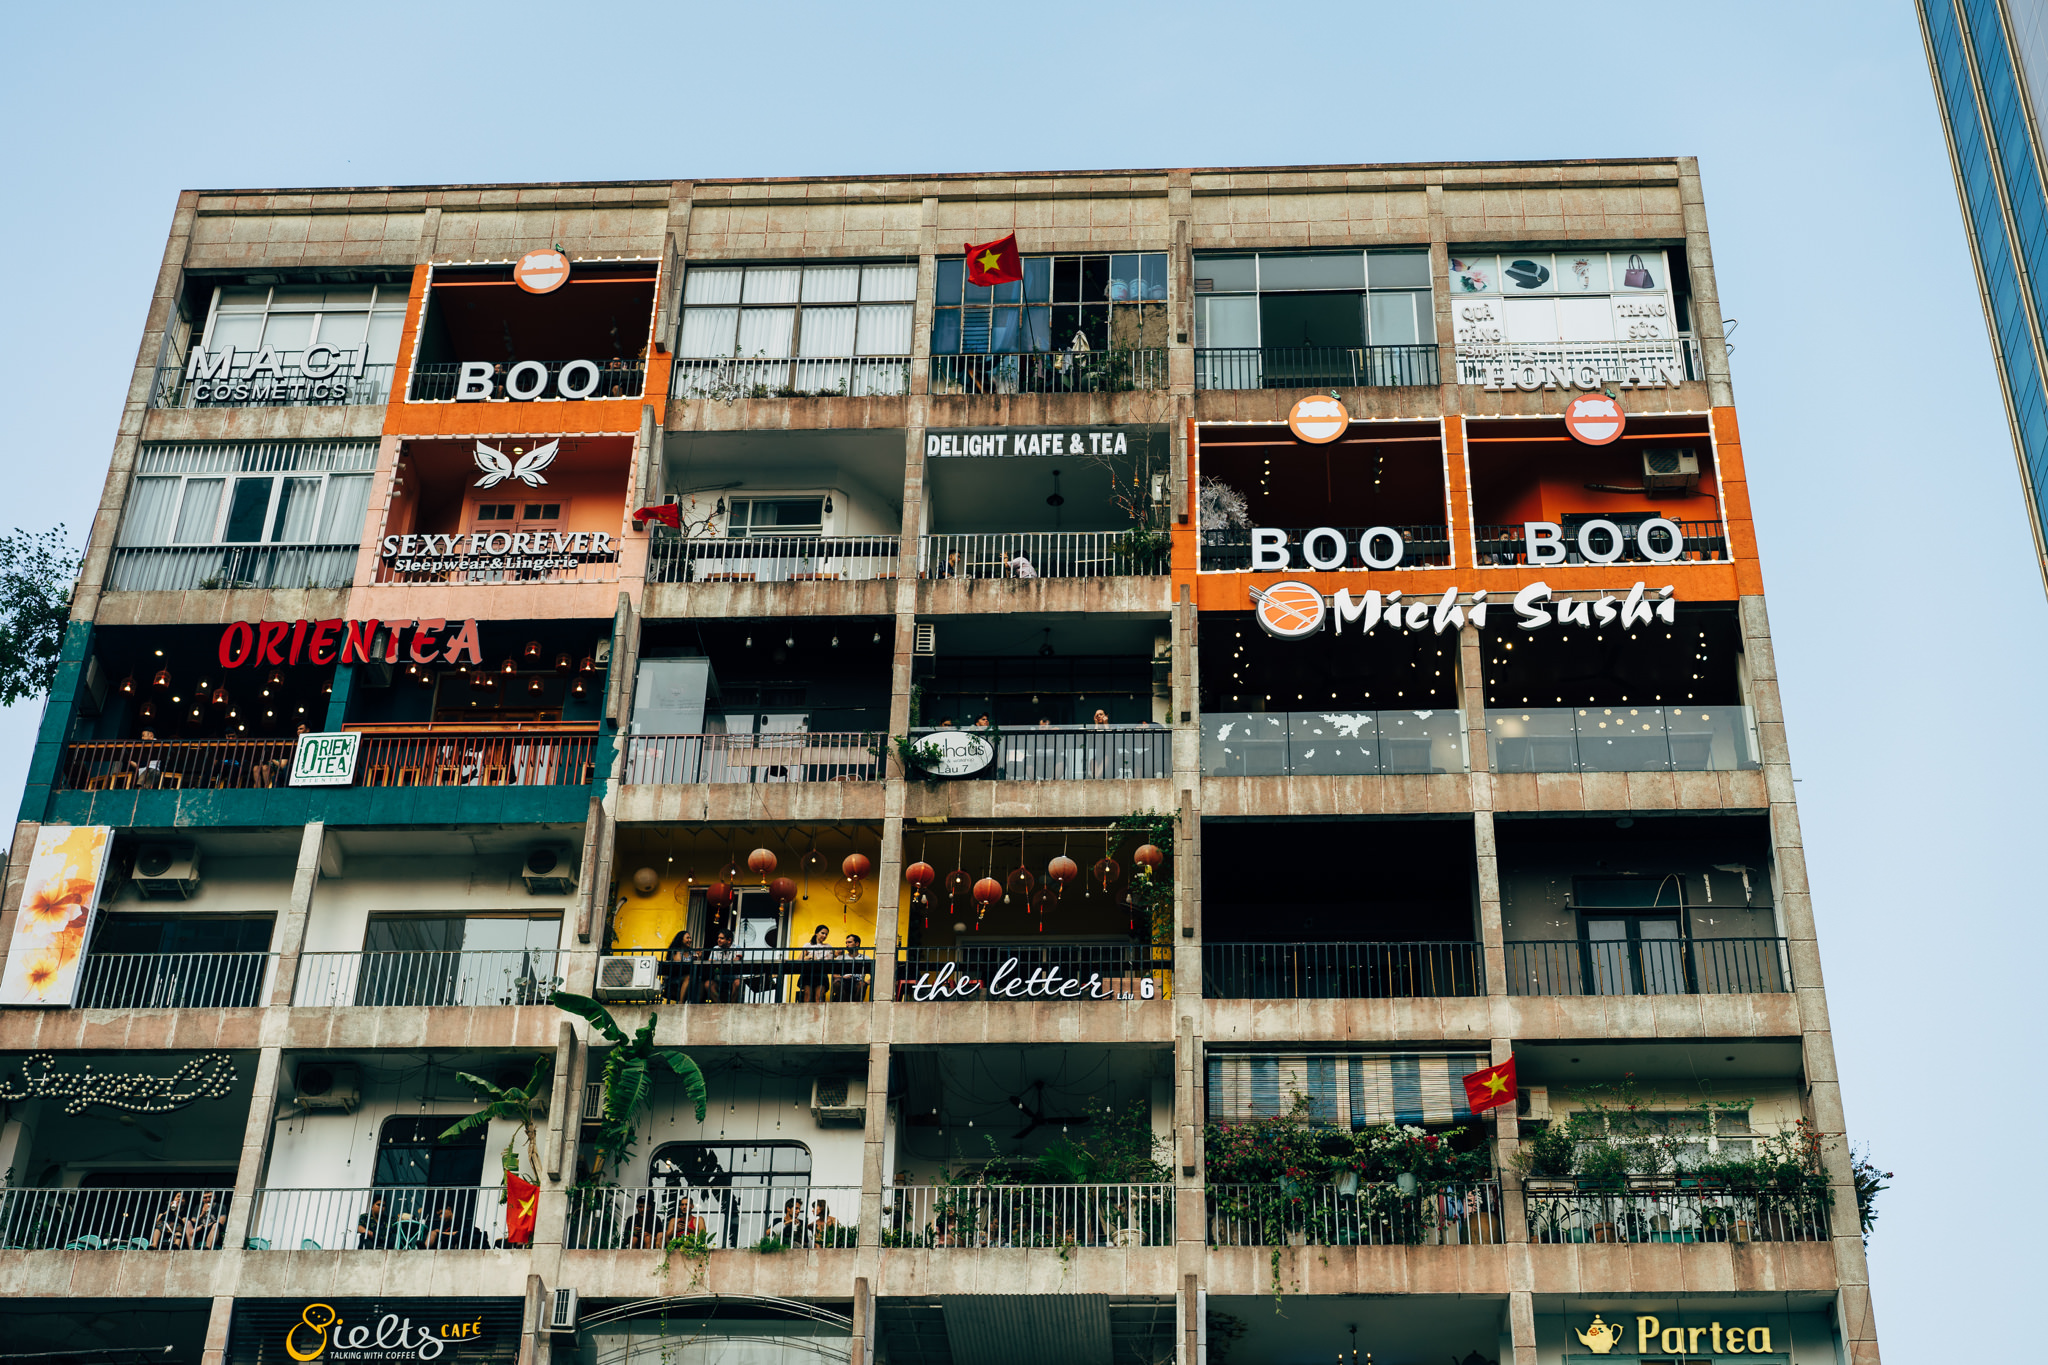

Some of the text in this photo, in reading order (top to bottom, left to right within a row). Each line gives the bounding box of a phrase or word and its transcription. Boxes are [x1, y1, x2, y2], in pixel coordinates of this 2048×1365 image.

[1616, 303, 1666, 318] TRANG
[185, 342, 370, 382] MACI
[456, 359, 600, 401] BOO
[194, 382, 348, 401] COSMETICS
[927, 432, 1127, 457] DELIGHT KAFE & TEA
[382, 531, 614, 558] SEXY FOREVER
[1251, 526, 1403, 571] BOO
[1523, 518, 1684, 566] BOO
[1333, 580, 1676, 637] Michi Sushi
[218, 618, 484, 668] ORIENTEA
[962, 764, 969, 773] 7
[912, 961, 980, 1001] the
[989, 957, 1114, 999] letter
[1140, 977, 1155, 999] 6
[440, 1315, 482, 1338] CAFÉ
[1636, 1315, 1774, 1354] Partea
[330, 1351, 416, 1360] TALKING WITH COFFEE
